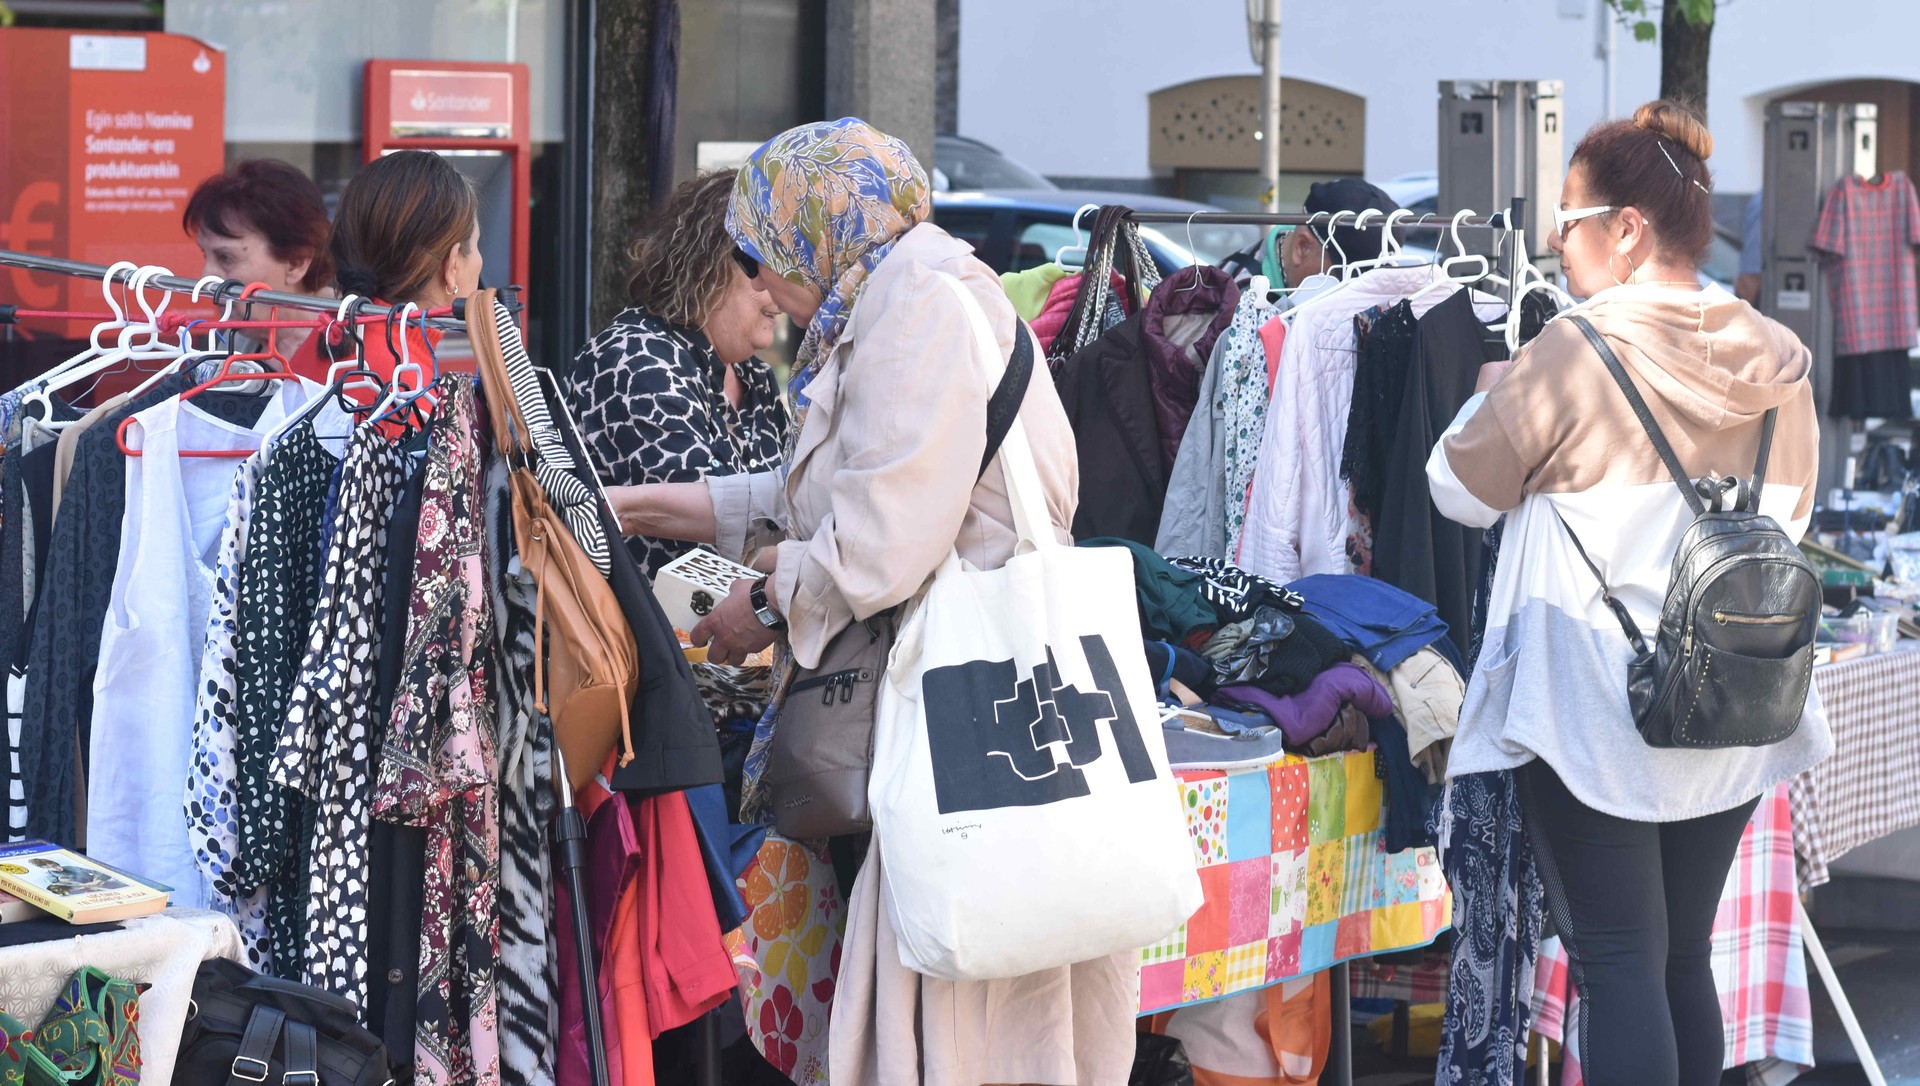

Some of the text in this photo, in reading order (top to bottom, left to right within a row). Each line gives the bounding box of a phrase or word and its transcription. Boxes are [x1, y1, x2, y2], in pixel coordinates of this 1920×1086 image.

[428, 92, 492, 111] Santander
[86, 109, 113, 133] Egin
[145, 110, 194, 130] Nomina
